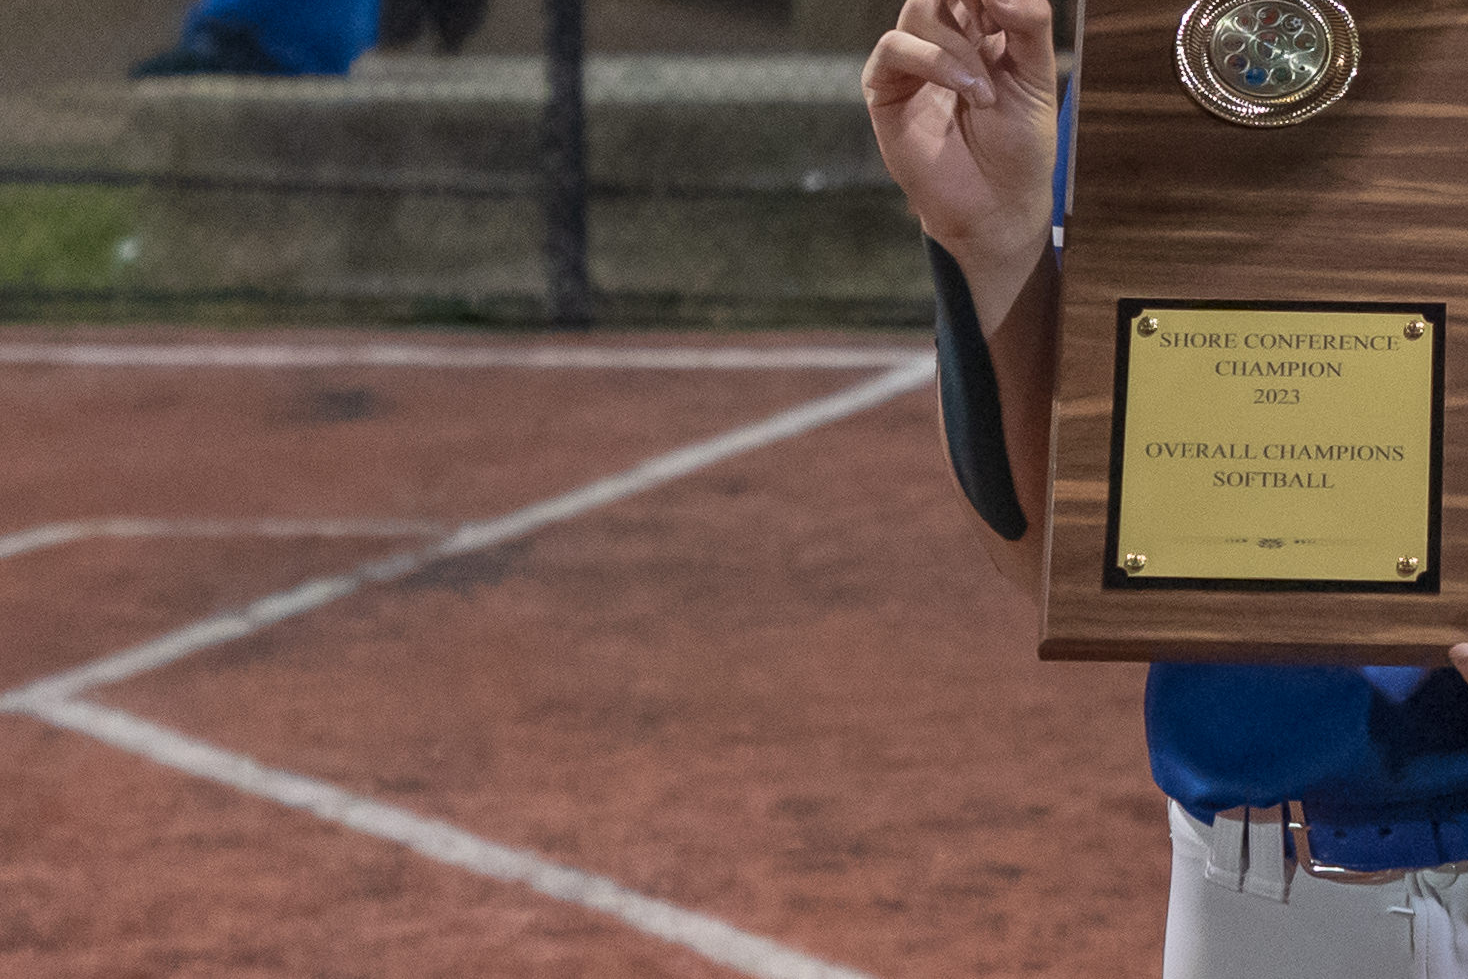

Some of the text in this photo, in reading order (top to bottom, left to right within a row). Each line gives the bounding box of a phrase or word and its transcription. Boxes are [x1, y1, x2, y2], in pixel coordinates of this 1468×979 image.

[1159, 332, 1400, 352] SHORE CONFERENCE
[1215, 360, 1343, 378] CHAMPION
[1253, 388, 1301, 405] 2023
[1145, 442, 1405, 462] OVERALL CHAMPIONS
[1212, 471, 1335, 489] SOFTBALL
